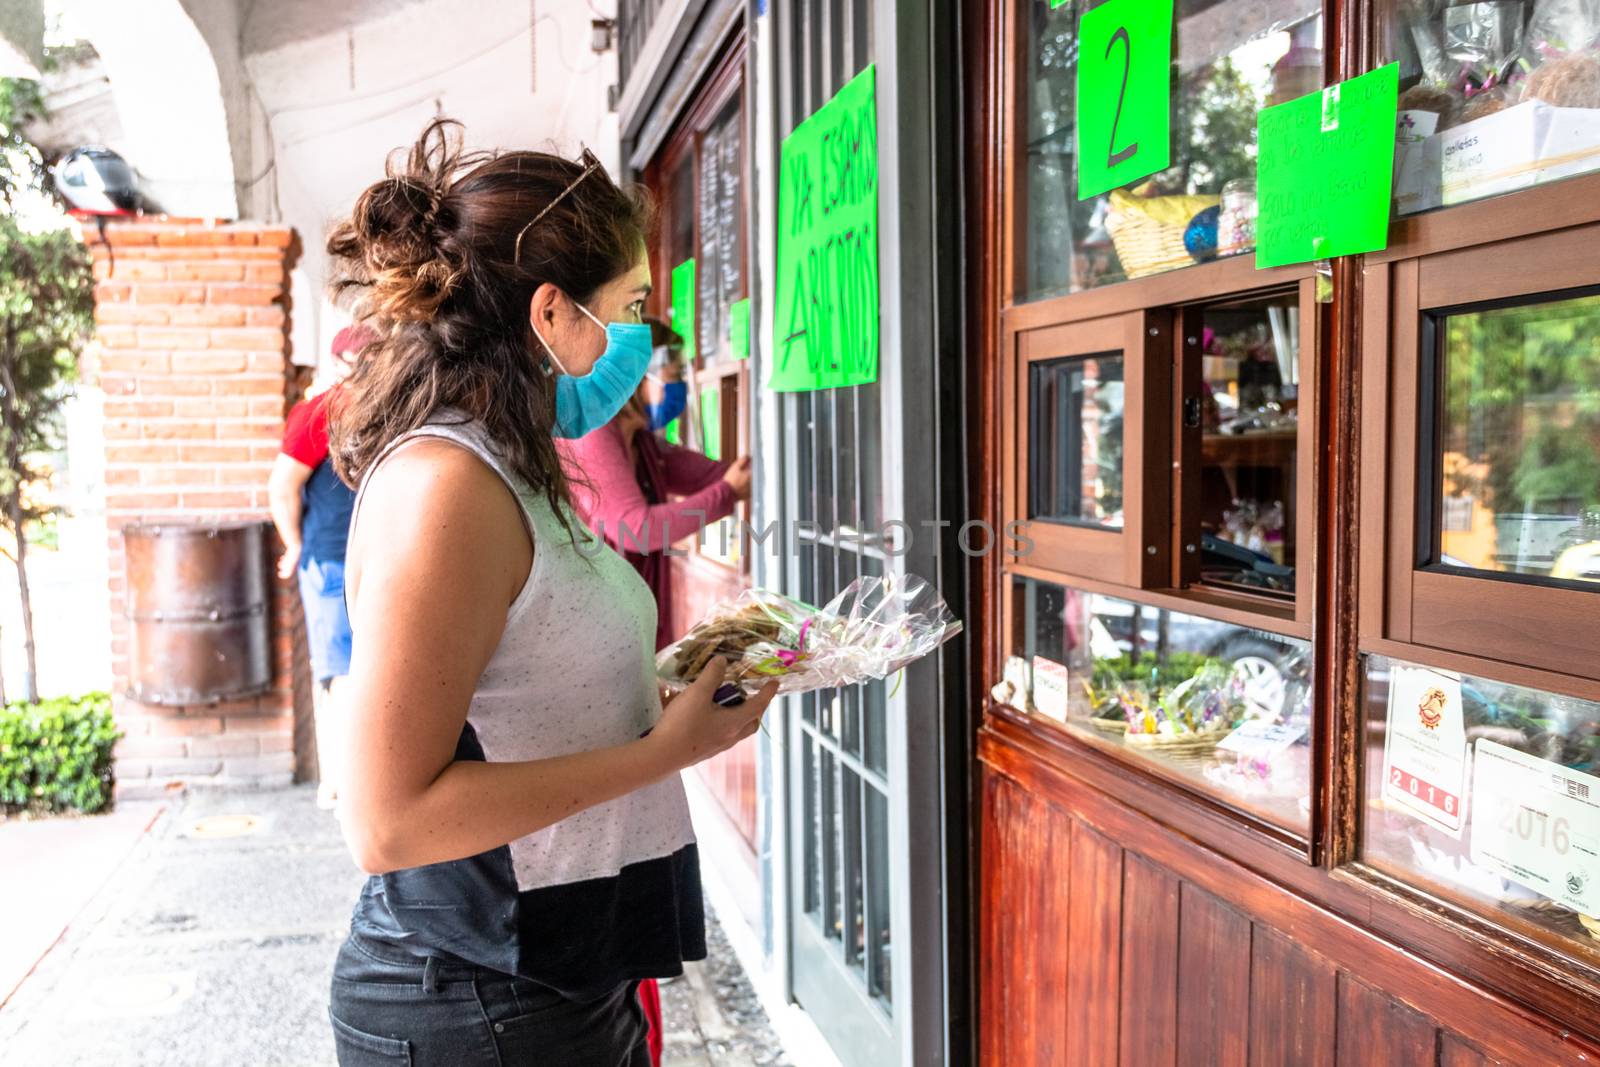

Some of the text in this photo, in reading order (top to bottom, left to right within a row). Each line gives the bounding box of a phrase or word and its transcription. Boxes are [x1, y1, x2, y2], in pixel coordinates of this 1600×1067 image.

[1104, 26, 1138, 169] 2
[789, 152, 813, 237] YA
[781, 222, 877, 377] ABIERTOS
[1498, 796, 1571, 856] 2016
